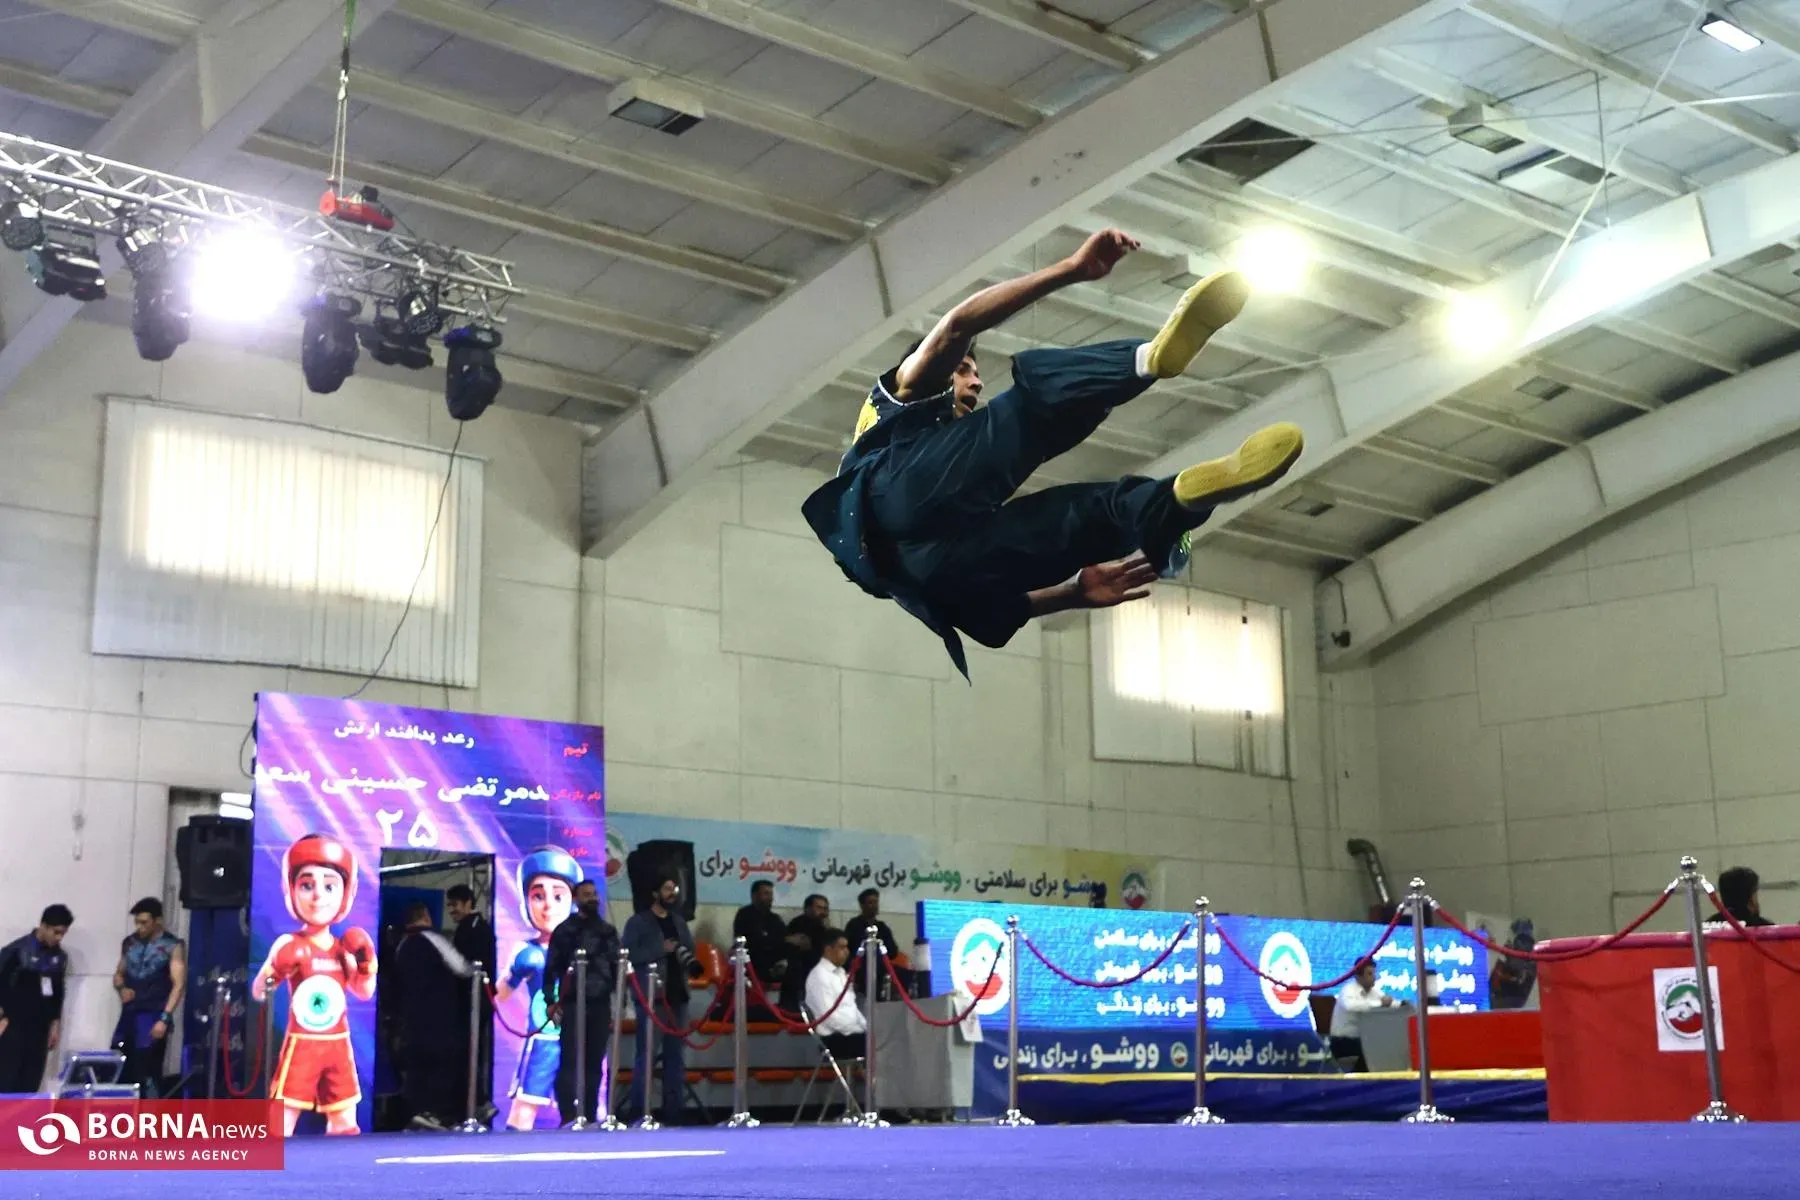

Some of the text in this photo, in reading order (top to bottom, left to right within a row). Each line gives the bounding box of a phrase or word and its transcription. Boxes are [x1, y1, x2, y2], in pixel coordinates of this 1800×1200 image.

[321, 767, 427, 794] حسینی
[375, 808, 438, 847] ۲۵
[699, 850, 734, 877] برای
[738, 847, 798, 883] ووشو
[812, 857, 871, 884] قهرمانی
[874, 861, 907, 887] برای
[909, 861, 962, 892] ووشو
[974, 869, 1026, 893] سلامتی
[1029, 871, 1059, 897] برای
[993, 1045, 1037, 1069] زندی
[1040, 1042, 1078, 1069] برای
[1256, 1041, 1288, 1067] برای
